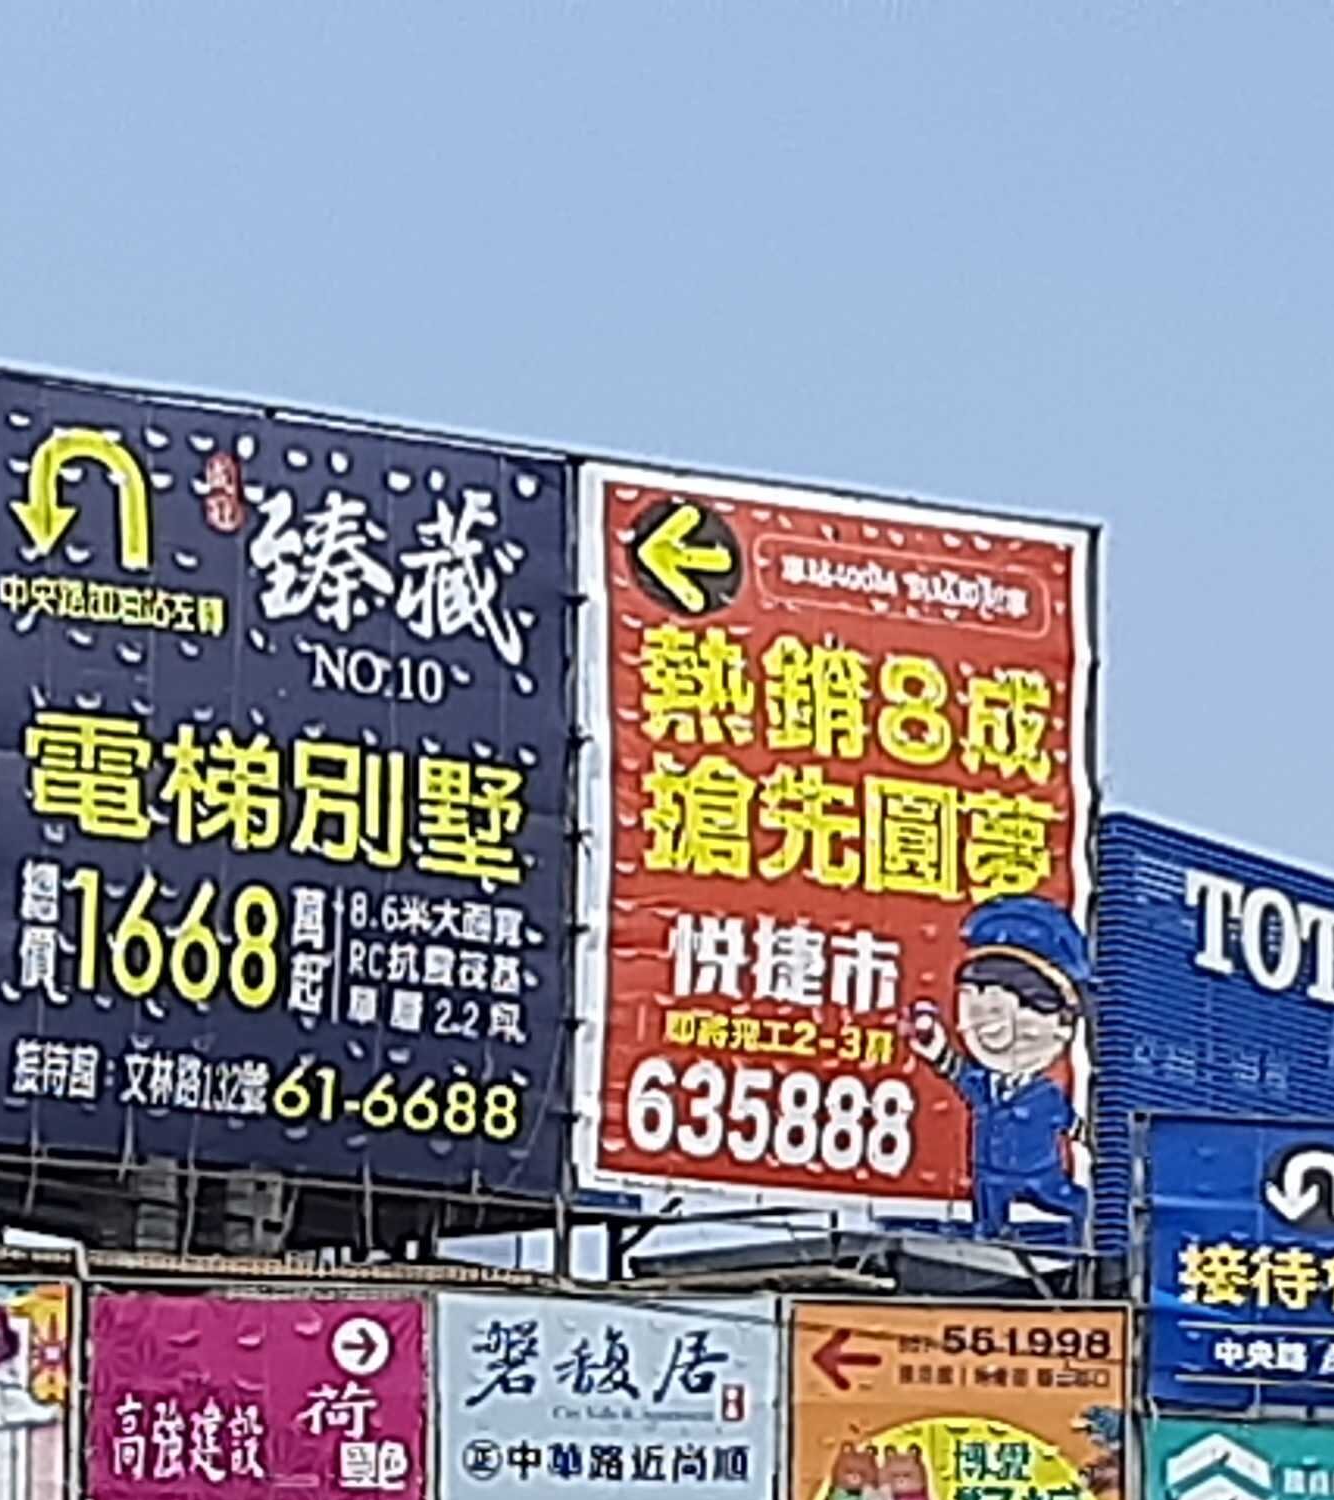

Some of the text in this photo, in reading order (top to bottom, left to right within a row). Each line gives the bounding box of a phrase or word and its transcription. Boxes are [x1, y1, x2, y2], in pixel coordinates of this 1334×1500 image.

[250, 489, 523, 665] 臻藏
[313, 643, 445, 703] NO.10
[640, 623, 1051, 785] 熱銷8成
[24, 710, 523, 885] 電梯別墅
[642, 752, 1065, 902] 搶先圓夢
[69, 867, 279, 1007] 1668
[668, 913, 900, 1014] 悅捷市
[272, 1064, 517, 1141] 61-6688
[627, 1055, 914, 1178] 635888
